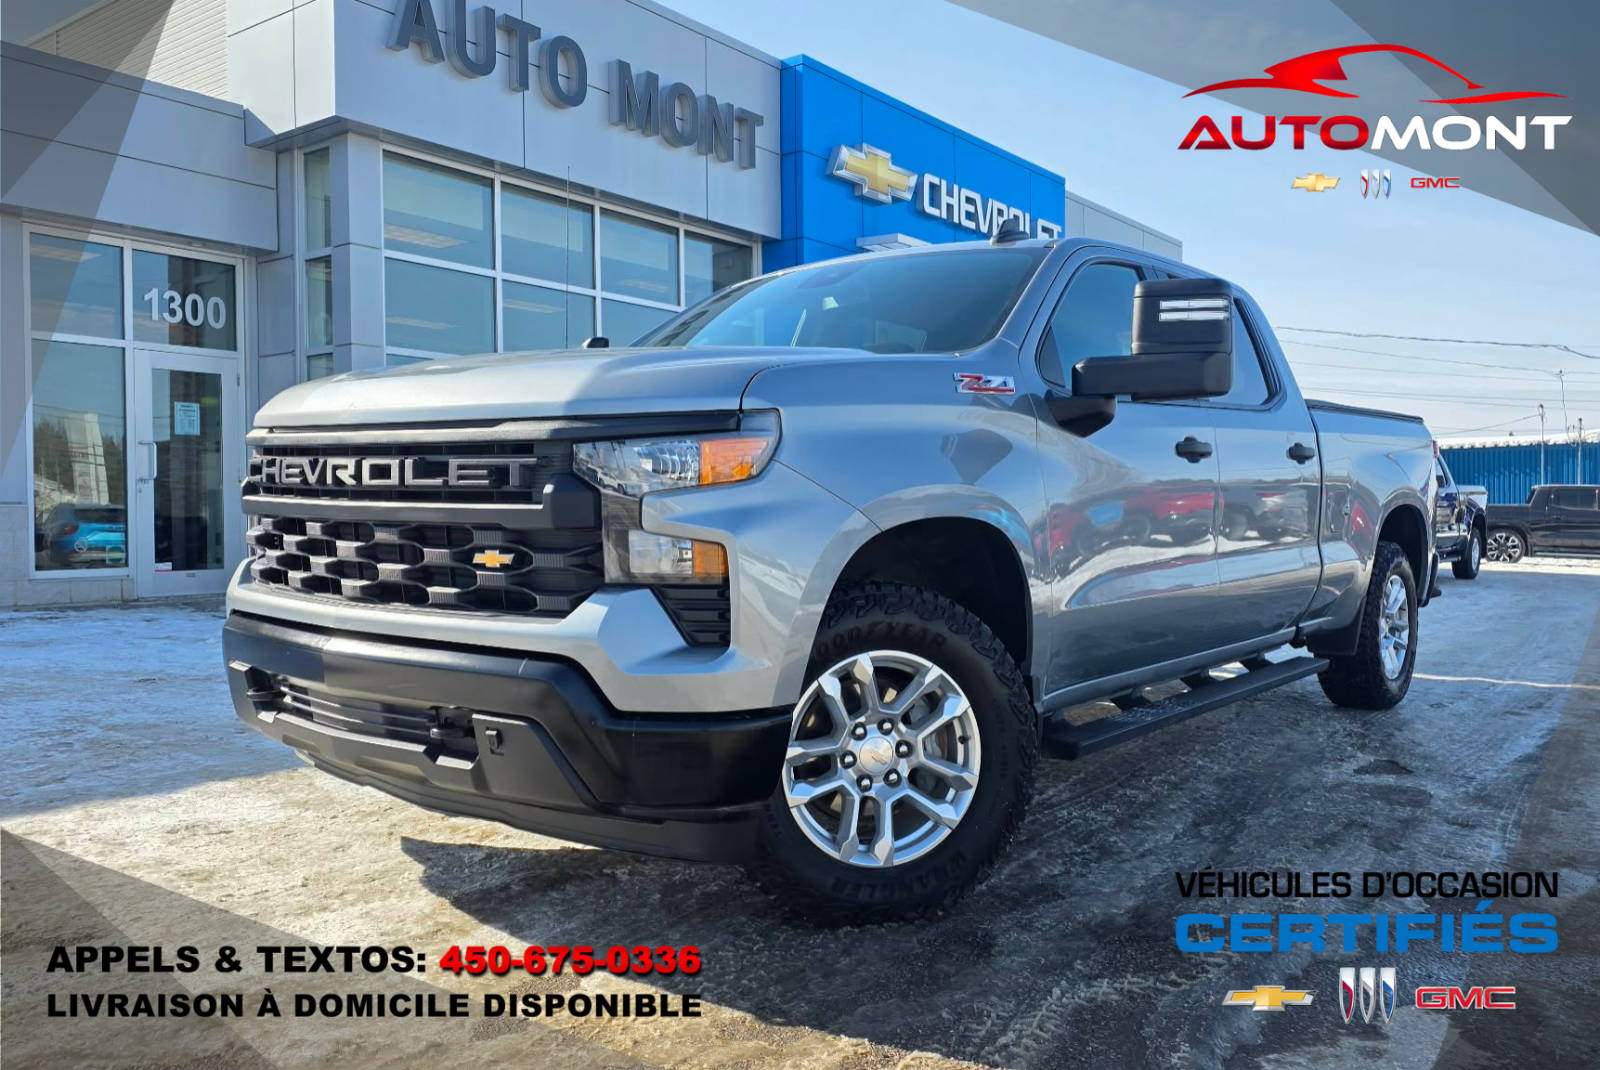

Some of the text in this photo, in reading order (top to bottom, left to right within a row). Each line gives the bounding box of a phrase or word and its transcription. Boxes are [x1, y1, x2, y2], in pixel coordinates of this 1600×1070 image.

[386, 0, 764, 171] AUTO MONT
[143, 287, 227, 329] 1300
[953, 372, 1016, 394] Z71
[247, 456, 542, 488] CHEVROLET
